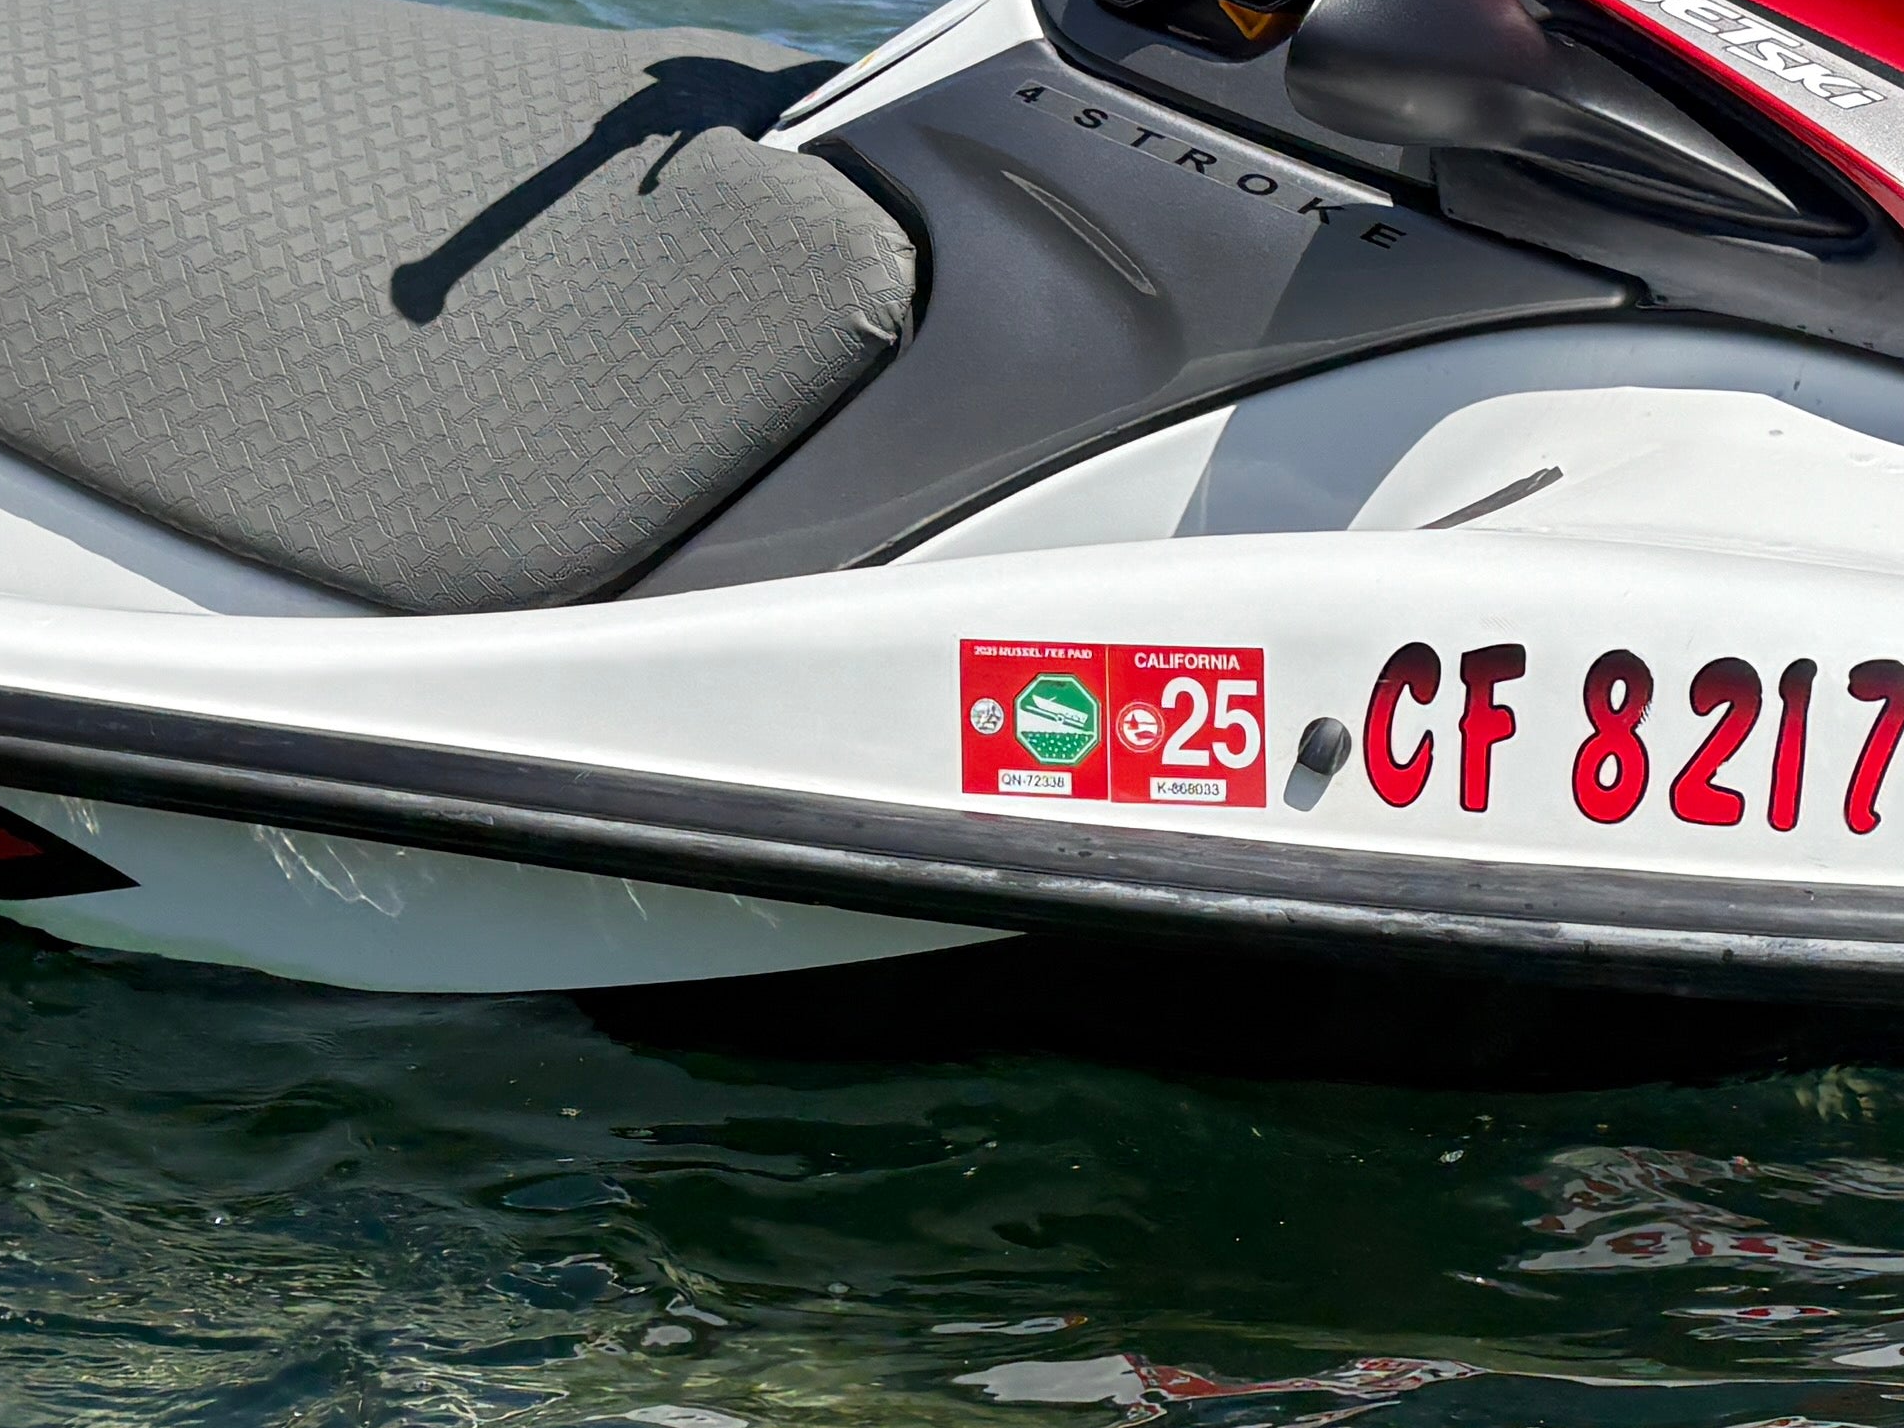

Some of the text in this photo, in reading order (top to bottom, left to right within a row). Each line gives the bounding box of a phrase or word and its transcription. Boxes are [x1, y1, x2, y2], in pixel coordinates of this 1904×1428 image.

[1014, 83, 1410, 251] 4 STROKE
[1067, 648, 1093, 660] PAID
[1134, 651, 1240, 671] CALIFORNIA
[1161, 676, 1262, 769] 25
[1363, 641, 1527, 813] CF
